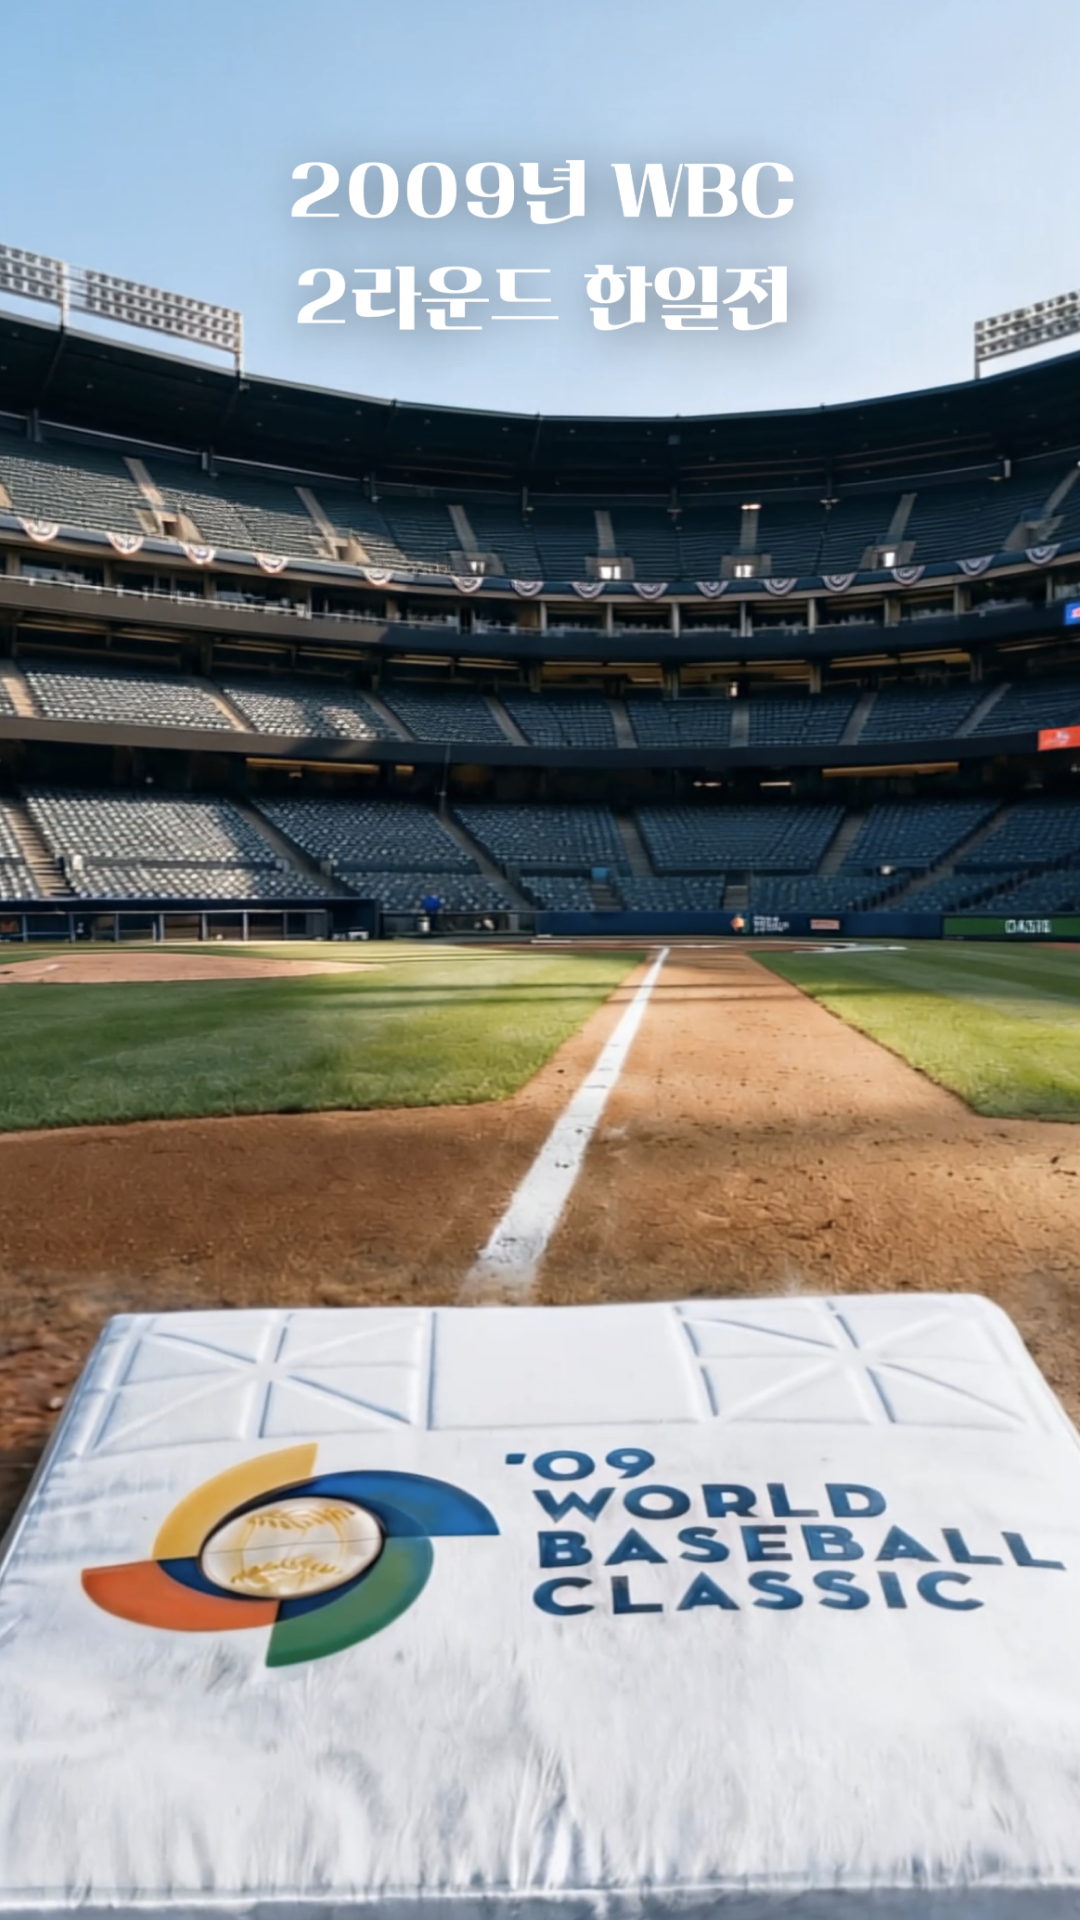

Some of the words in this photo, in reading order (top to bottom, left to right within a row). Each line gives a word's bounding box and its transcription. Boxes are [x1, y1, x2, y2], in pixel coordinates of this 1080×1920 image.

[532, 1482, 887, 1523] WORLD
[537, 1524, 1066, 1571] BASEBALL
[532, 1570, 985, 1616] CLASSIC
